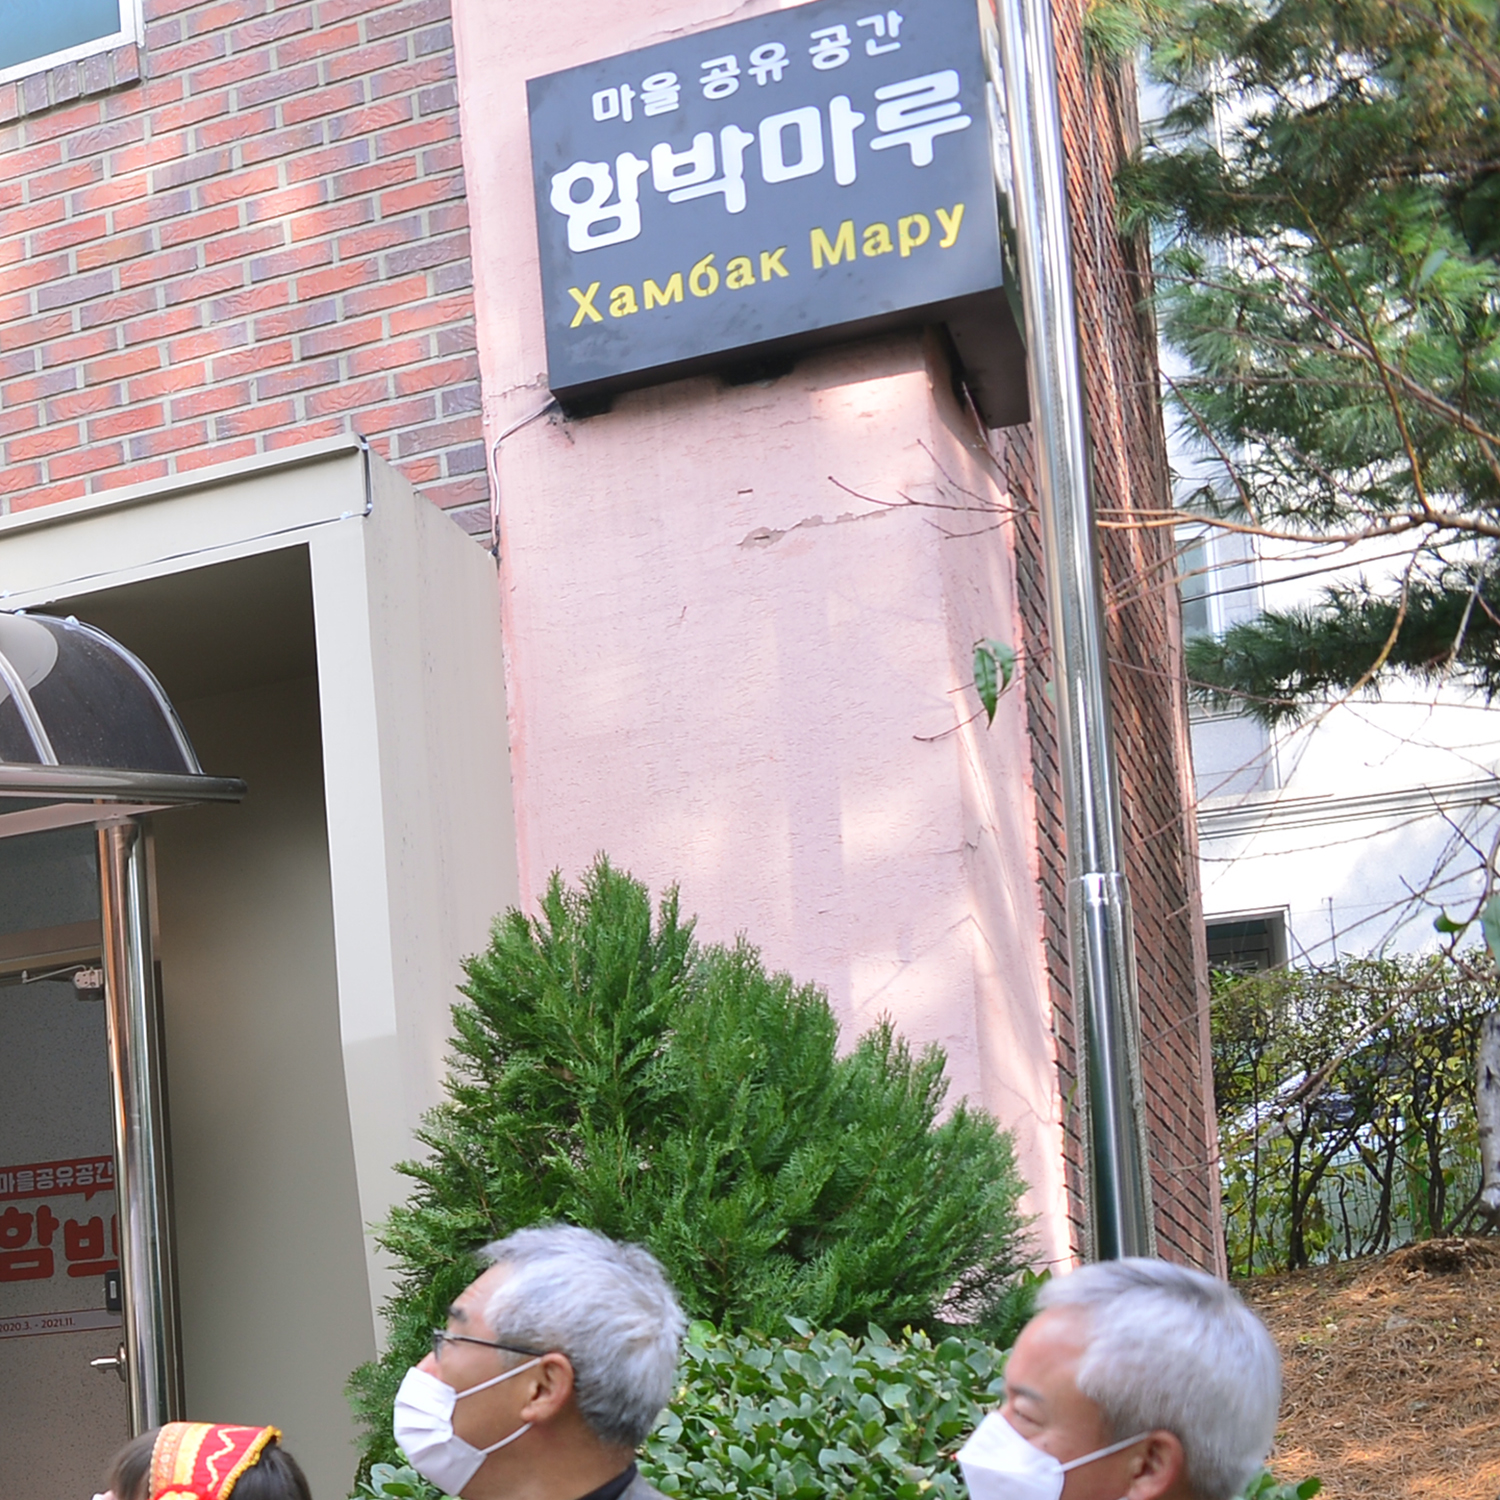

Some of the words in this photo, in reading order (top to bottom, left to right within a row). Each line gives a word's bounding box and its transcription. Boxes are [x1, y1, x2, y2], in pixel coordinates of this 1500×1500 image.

[591, 71, 682, 123] 마을
[698, 41, 790, 100] 공유
[807, 10, 903, 71] 공간
[549, 69, 973, 254] 함박마루
[567, 245, 790, 329] Хамбак
[809, 203, 966, 270] Мару
